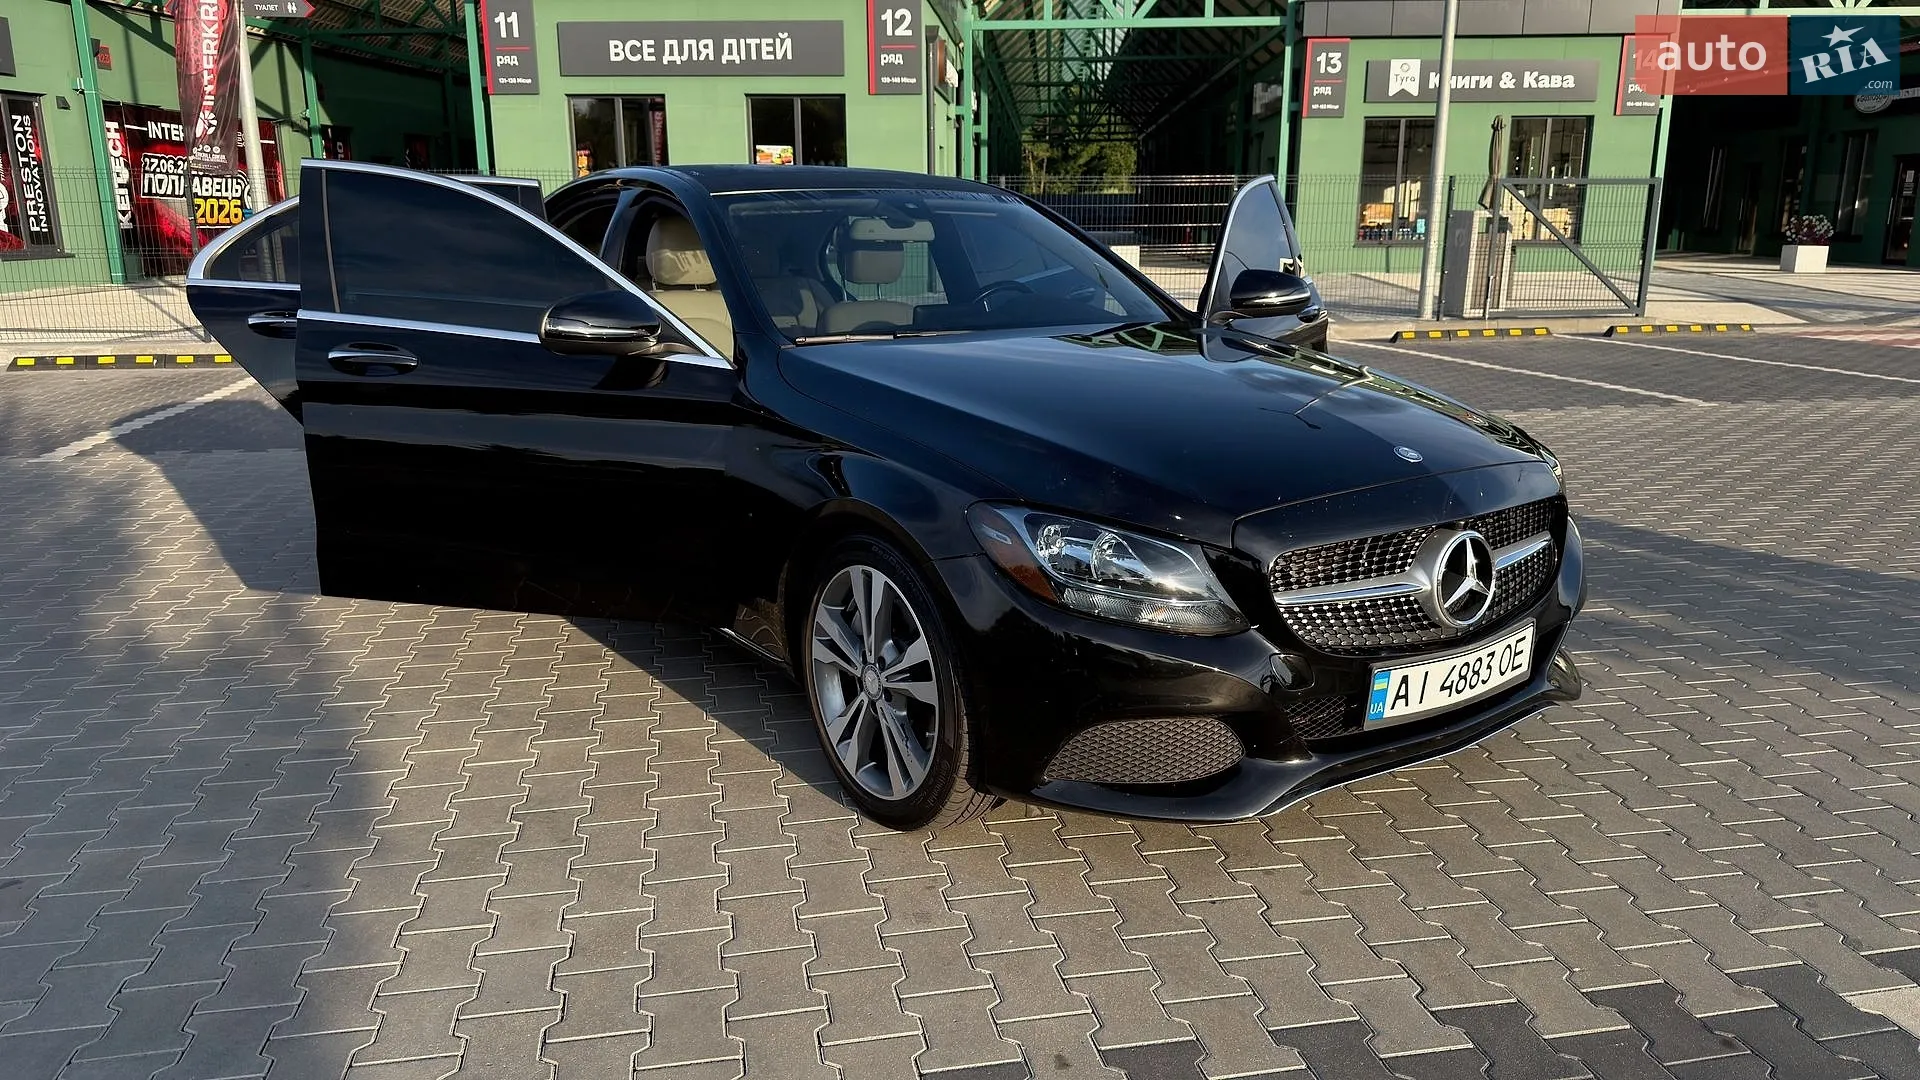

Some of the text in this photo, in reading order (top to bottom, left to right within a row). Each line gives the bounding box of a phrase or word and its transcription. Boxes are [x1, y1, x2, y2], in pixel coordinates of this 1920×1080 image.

[494, 11, 520, 38] 11
[881, 8, 913, 36] 12
[609, 32, 793, 65] ВСЕ ДЛЯ ДІТЕЙ
[881, 53, 904, 66] ряд
[1633, 49, 1658, 71] 14
[496, 55, 519, 67] ряд
[1316, 52, 1343, 74] 13
[1313, 86, 1332, 97] ряд
[1499, 71, 1516, 89] &
[1523, 70, 1575, 89] Кава
[11, 114, 41, 233] PRESTON
[22, 114, 49, 233] INNOVATIONS
[194, 198, 243, 225] 2026
[1390, 636, 1526, 710] AI 4883 OE
[1370, 701, 1384, 714] UA
